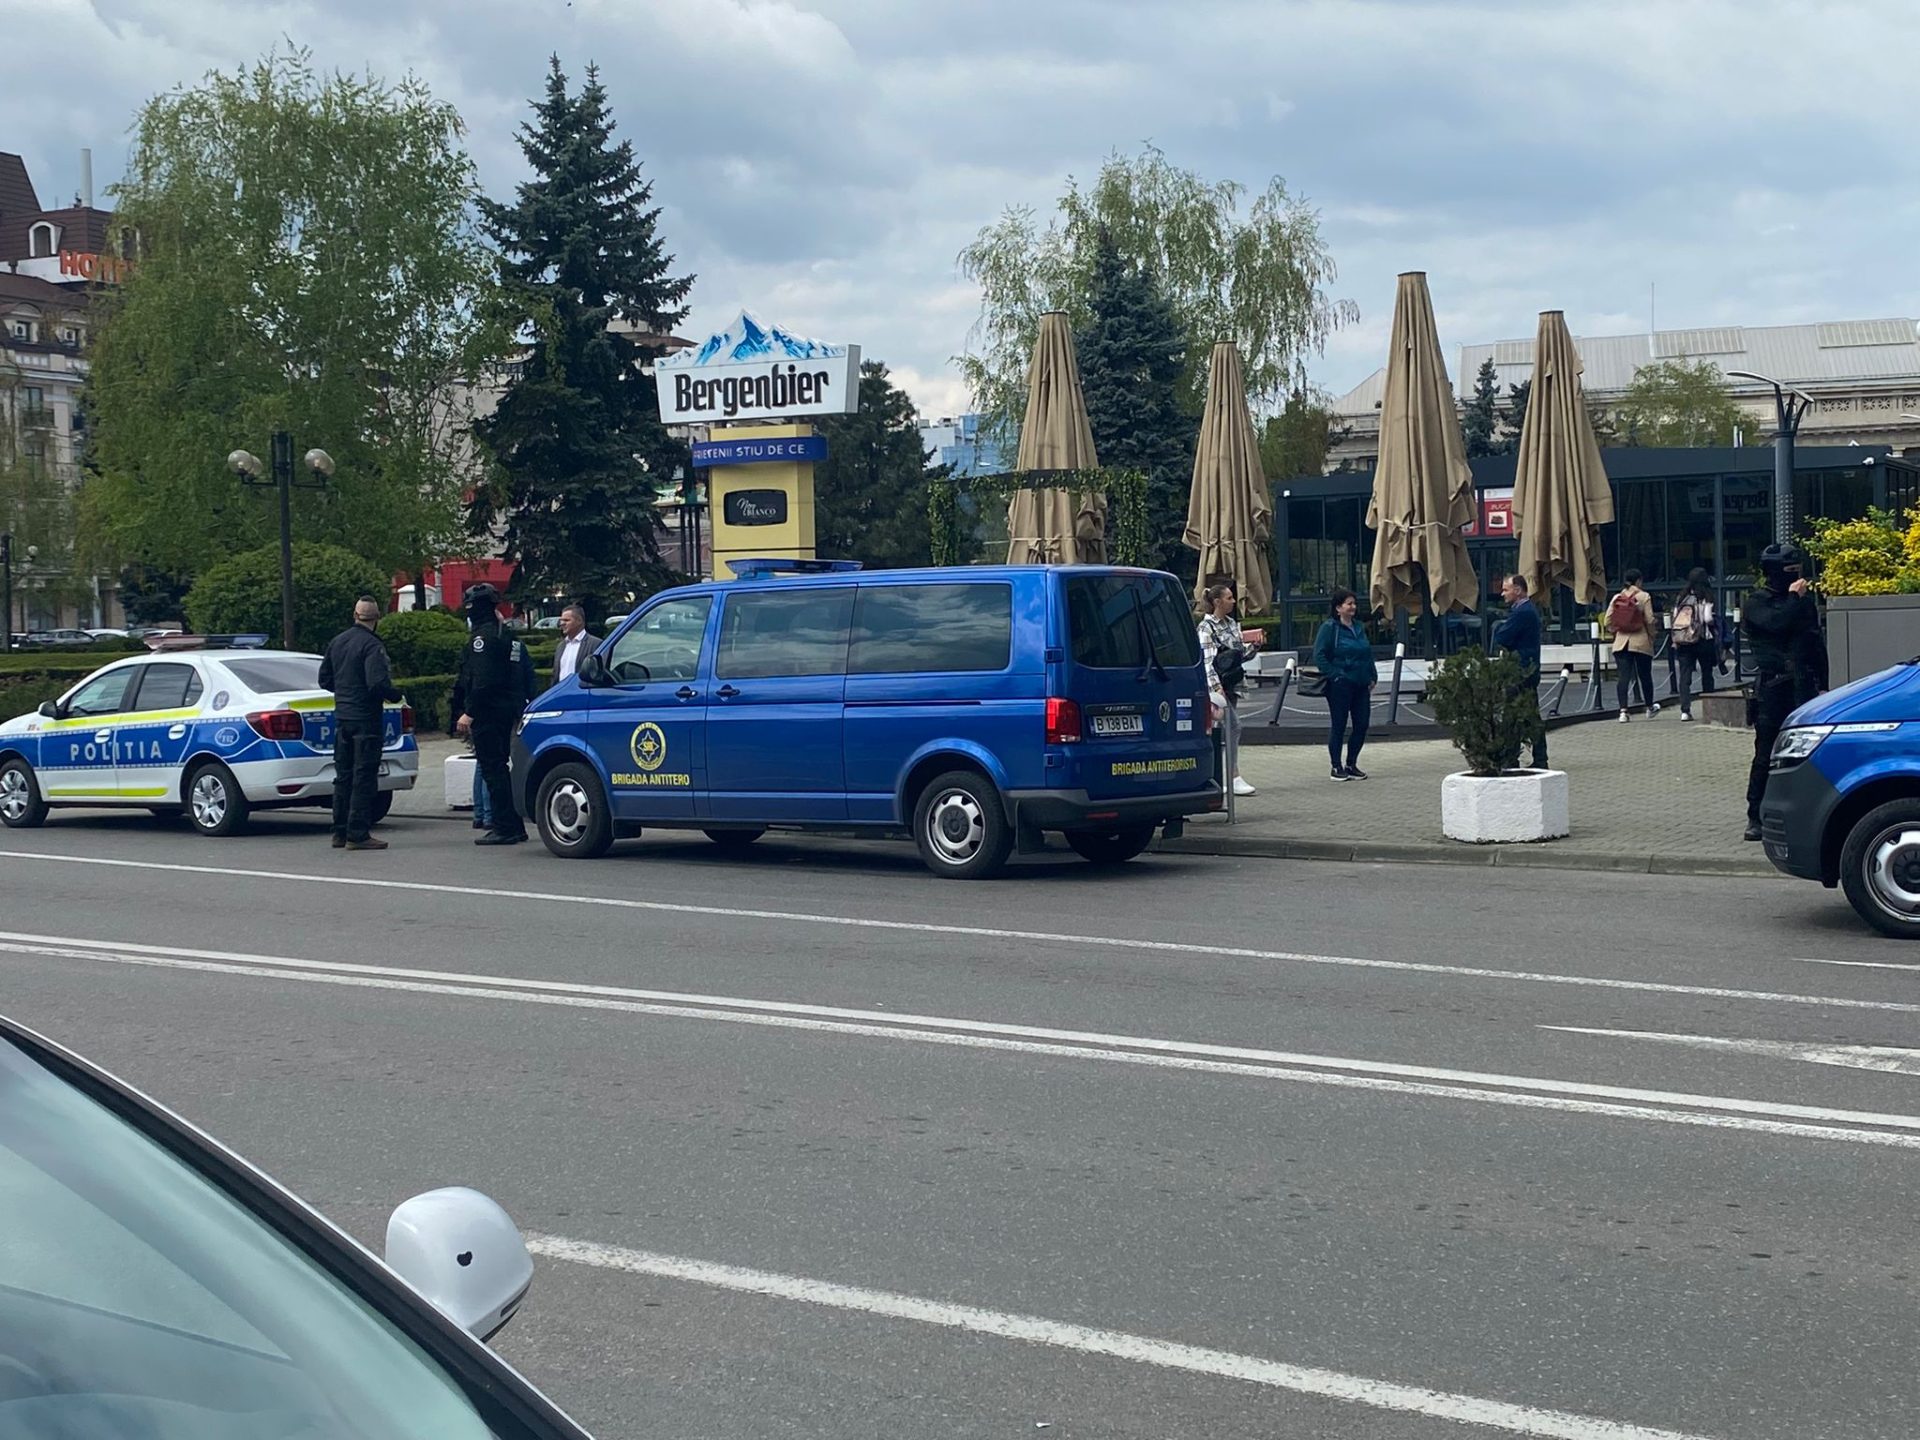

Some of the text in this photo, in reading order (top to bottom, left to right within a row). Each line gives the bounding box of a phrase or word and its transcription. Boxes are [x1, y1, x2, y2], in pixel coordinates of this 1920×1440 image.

[60, 249, 136, 283] HOTE
[674, 364, 830, 417] Bergenbier
[767, 444, 784, 455] DE
[788, 443, 805, 455] CE
[1096, 717, 1104, 731] B
[1122, 715, 1141, 730] BAT
[70, 740, 162, 761] POLITIA
[1111, 761, 1147, 776] BRIGADA
[611, 773, 690, 786] BRIGADA ANTITERO
